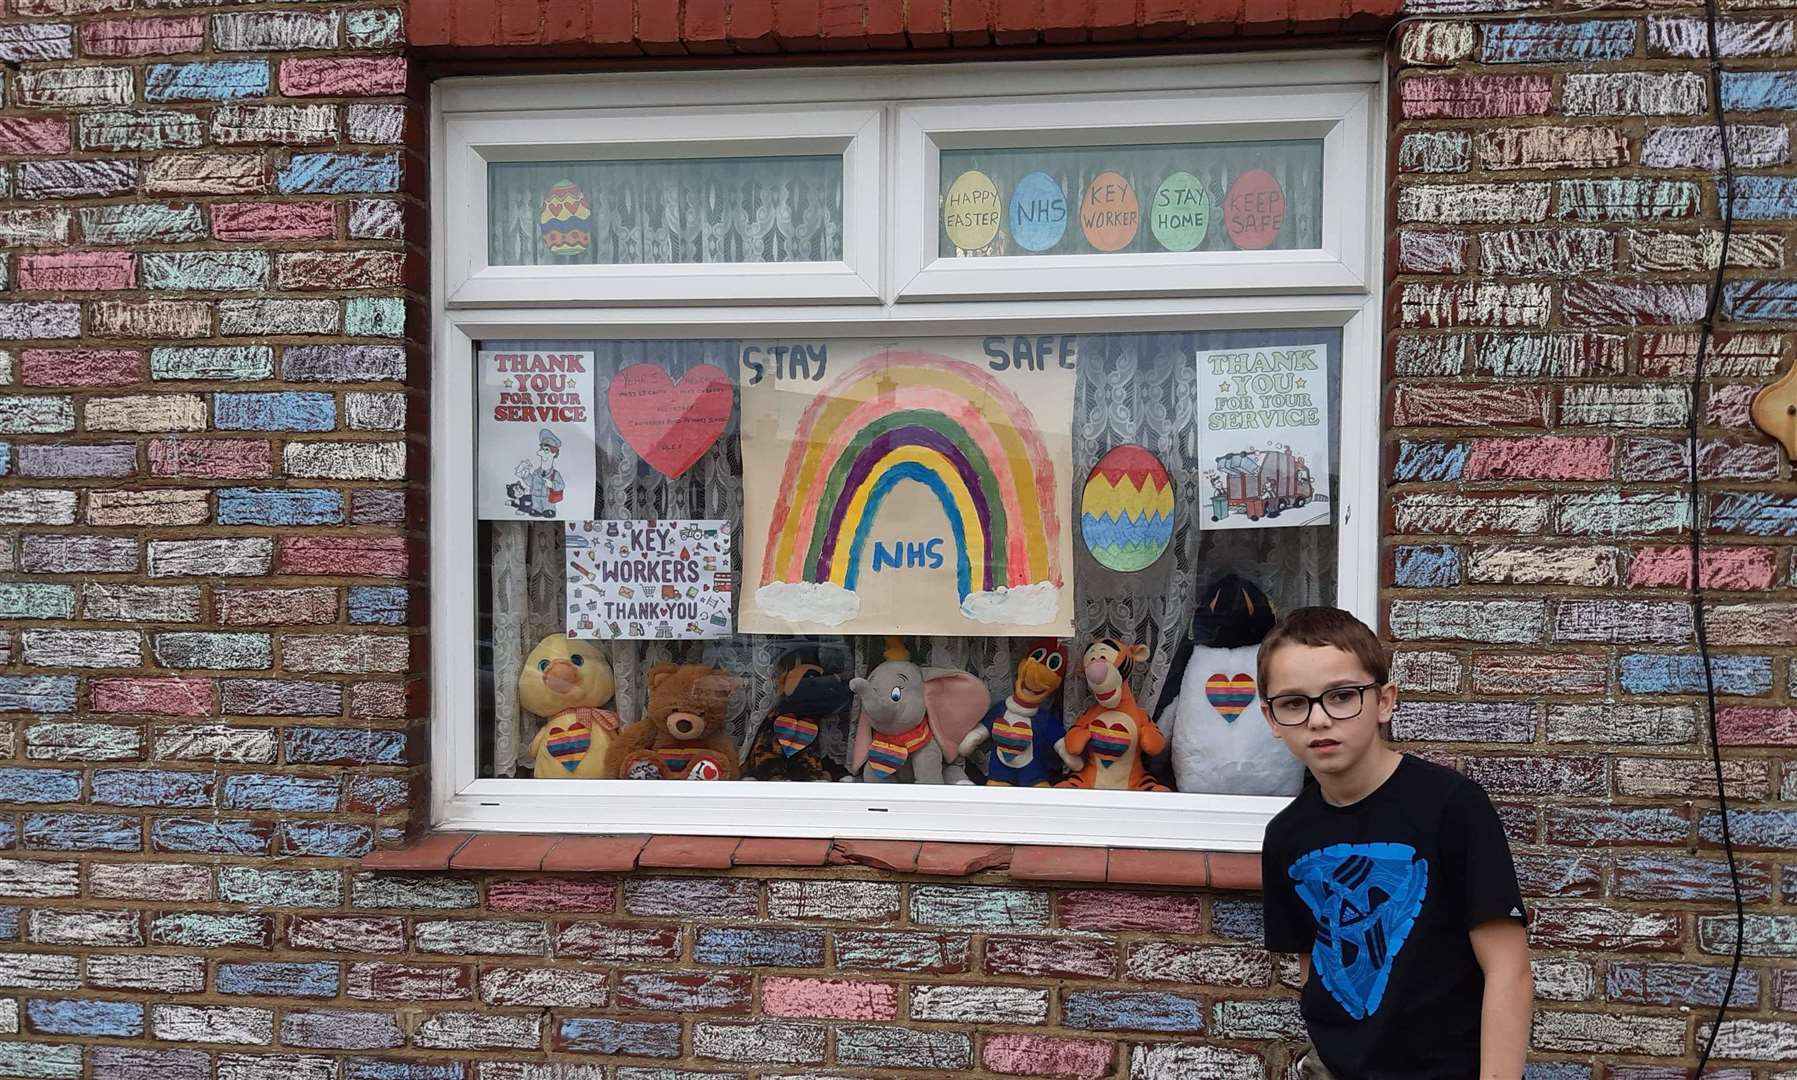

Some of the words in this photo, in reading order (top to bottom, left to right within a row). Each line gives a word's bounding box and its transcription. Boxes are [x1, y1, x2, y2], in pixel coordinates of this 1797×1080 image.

[949, 190, 998, 207] HAPPY
[1090, 184, 1128, 206] KEY
[1158, 188, 1206, 207] STAY
[1230, 191, 1278, 212] KEEP
[946, 212, 999, 227] EASTER
[1017, 200, 1067, 225] NHS
[1083, 212, 1137, 228] WORKER
[1158, 213, 1204, 228] HOME
[1231, 216, 1282, 234] SAFE
[494, 354, 586, 373] THANK
[743, 343, 827, 384] STAY
[982, 335, 1077, 372] SAFE
[1208, 349, 1318, 375] THANK
[514, 374, 567, 392] YOU
[1231, 373, 1295, 396] YOU
[499, 392, 534, 405] FOR
[536, 392, 581, 405] YOUR
[1215, 396, 1254, 411] FOR
[1259, 393, 1312, 409] YOUR
[494, 405, 587, 423] SERVICE
[1208, 408, 1319, 431] SERVICE
[630, 528, 670, 551] KEY
[871, 537, 945, 572] NHS
[602, 559, 700, 583] WORKERS
[604, 602, 660, 620] THANK
[667, 602, 698, 620] YOU
